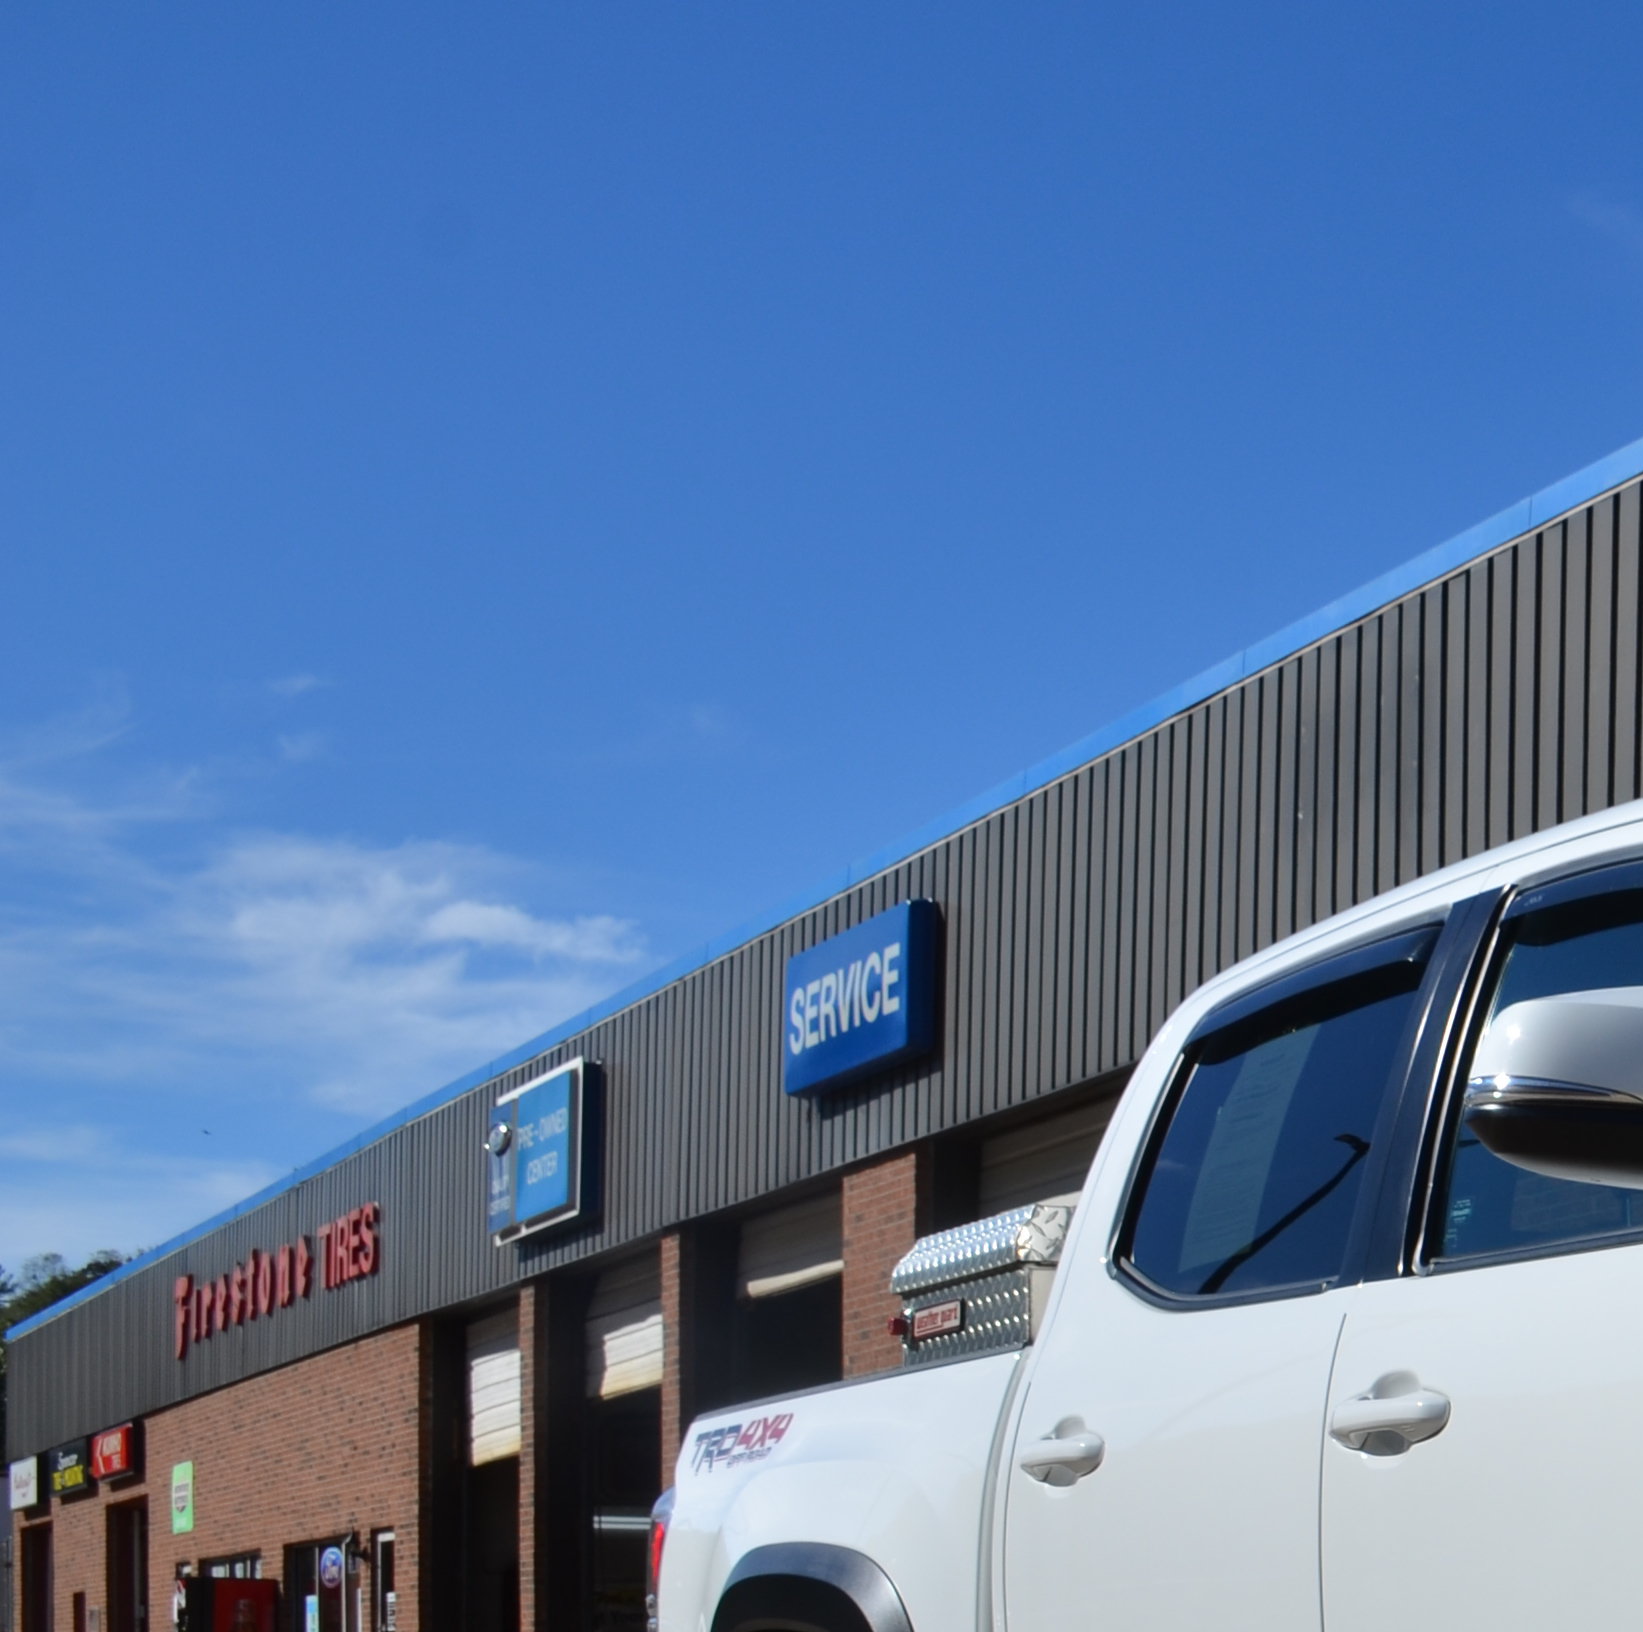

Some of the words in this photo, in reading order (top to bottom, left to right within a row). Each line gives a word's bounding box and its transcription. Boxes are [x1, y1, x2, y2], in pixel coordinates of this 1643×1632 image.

[789, 941, 901, 1056] SERVICE
[175, 1233, 313, 1360] Firestone
[317, 1201, 381, 1290] TIRES
